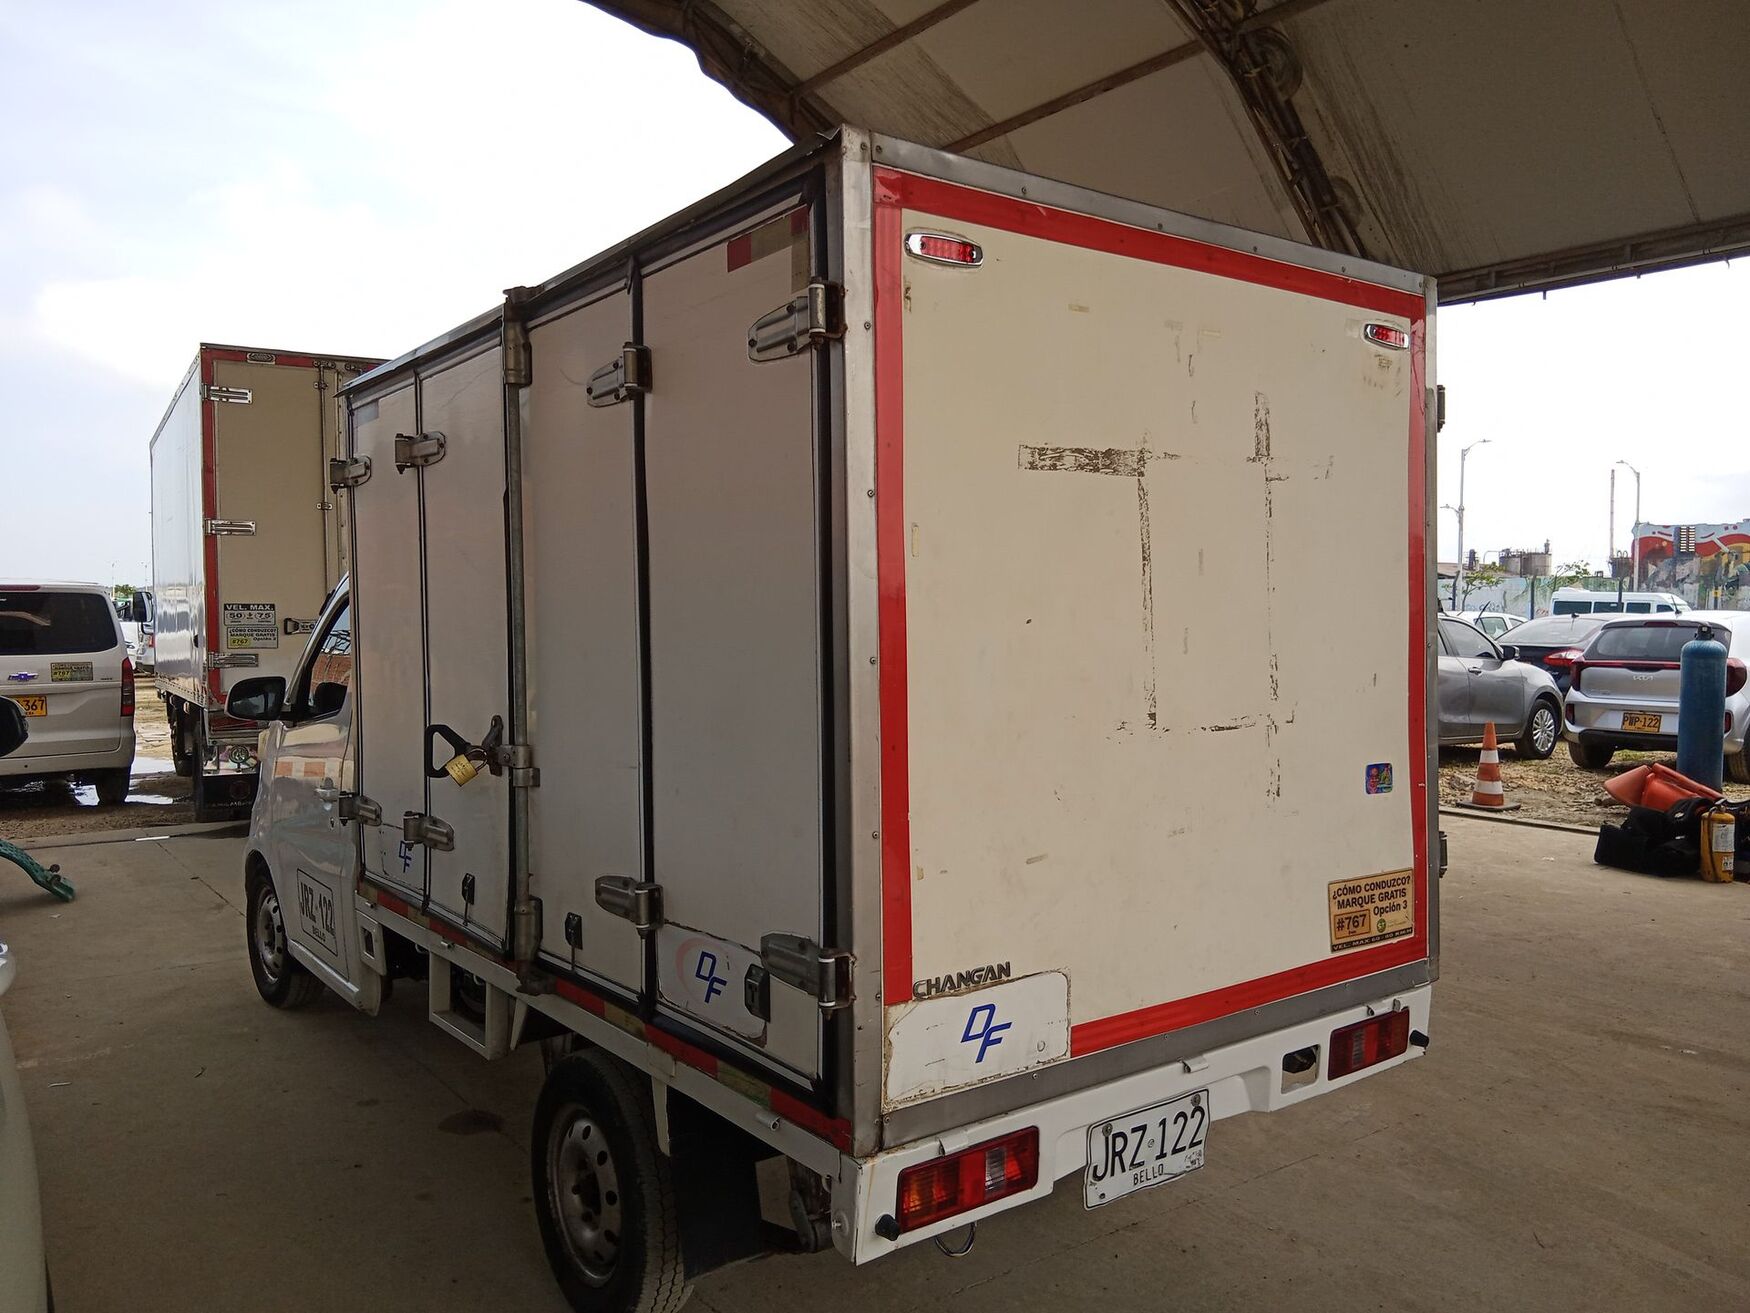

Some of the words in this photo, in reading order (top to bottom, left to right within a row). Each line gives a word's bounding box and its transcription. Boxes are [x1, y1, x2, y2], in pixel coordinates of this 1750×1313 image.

[16, 699, 45, 711] 367
[1332, 883, 1361, 900] ¿CÓMO
[1363, 875, 1411, 893] CONDUZCO?
[1337, 893, 1376, 910] MARQUE
[1377, 887, 1407, 903] GRATIS
[1373, 903, 1401, 917] Opción
[1402, 900, 1408, 910] 3
[1336, 914, 1367, 931] #767
[695, 951, 727, 1004] DF
[912, 961, 1012, 999] CHANGAN
[960, 1003, 1013, 1064] DF
[1133, 1163, 1164, 1186] BELLO
